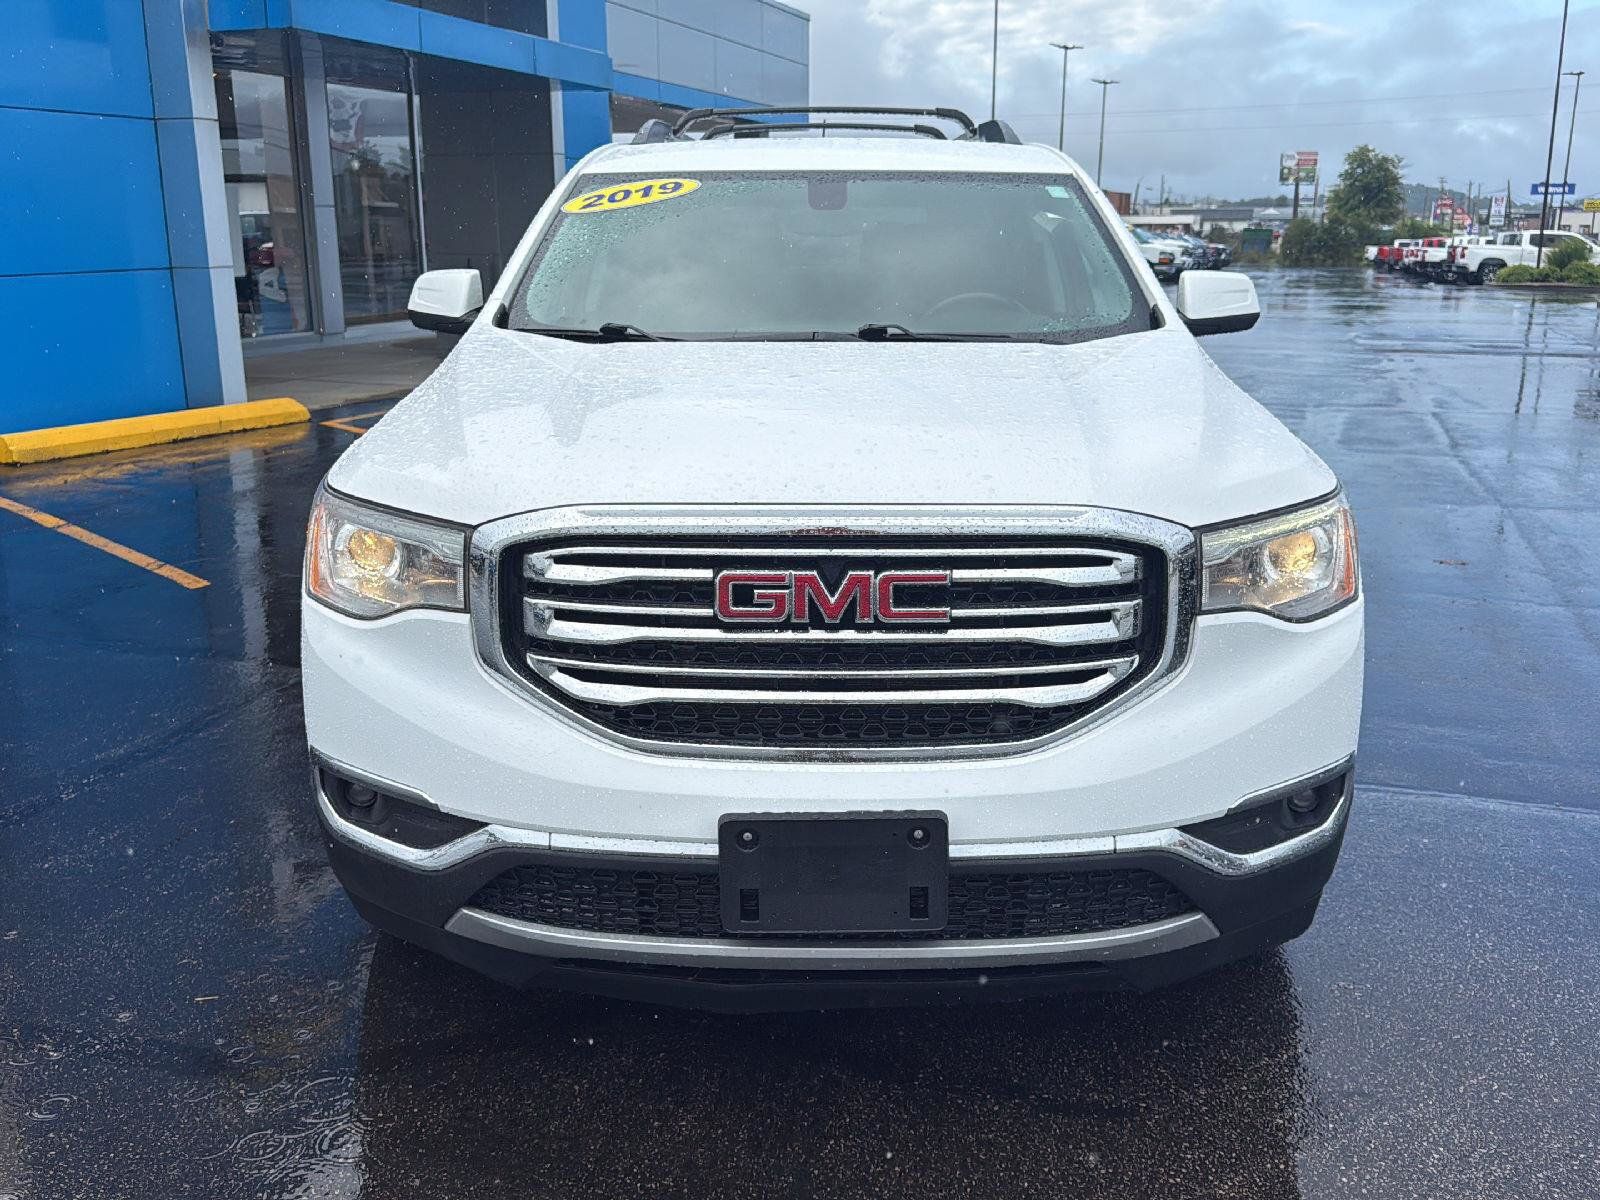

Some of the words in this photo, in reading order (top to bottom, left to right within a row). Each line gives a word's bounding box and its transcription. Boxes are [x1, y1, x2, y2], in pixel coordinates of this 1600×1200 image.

[579, 181, 684, 210] 2019
[1537, 185, 1569, 194] Wlmat
[715, 569, 952, 623] GMC
